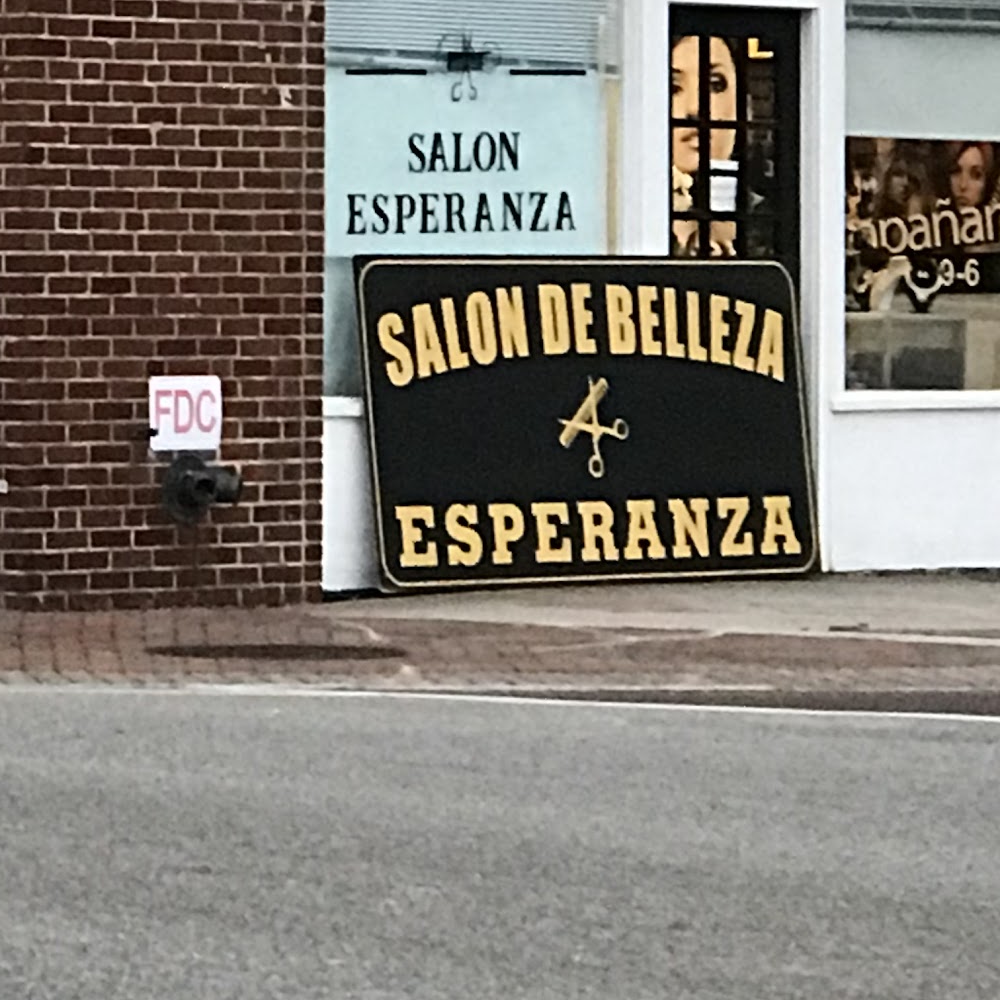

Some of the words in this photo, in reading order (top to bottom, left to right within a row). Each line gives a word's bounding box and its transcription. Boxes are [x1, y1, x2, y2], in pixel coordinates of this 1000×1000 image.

[408, 132, 520, 173] SALON
[347, 191, 576, 234] ESPERANZA
[377, 285, 530, 387] SALON
[538, 282, 597, 356] DE
[605, 283, 786, 383] BELLEZA
[154, 389, 217, 434] FDC
[394, 495, 802, 568] ESPERANZA
